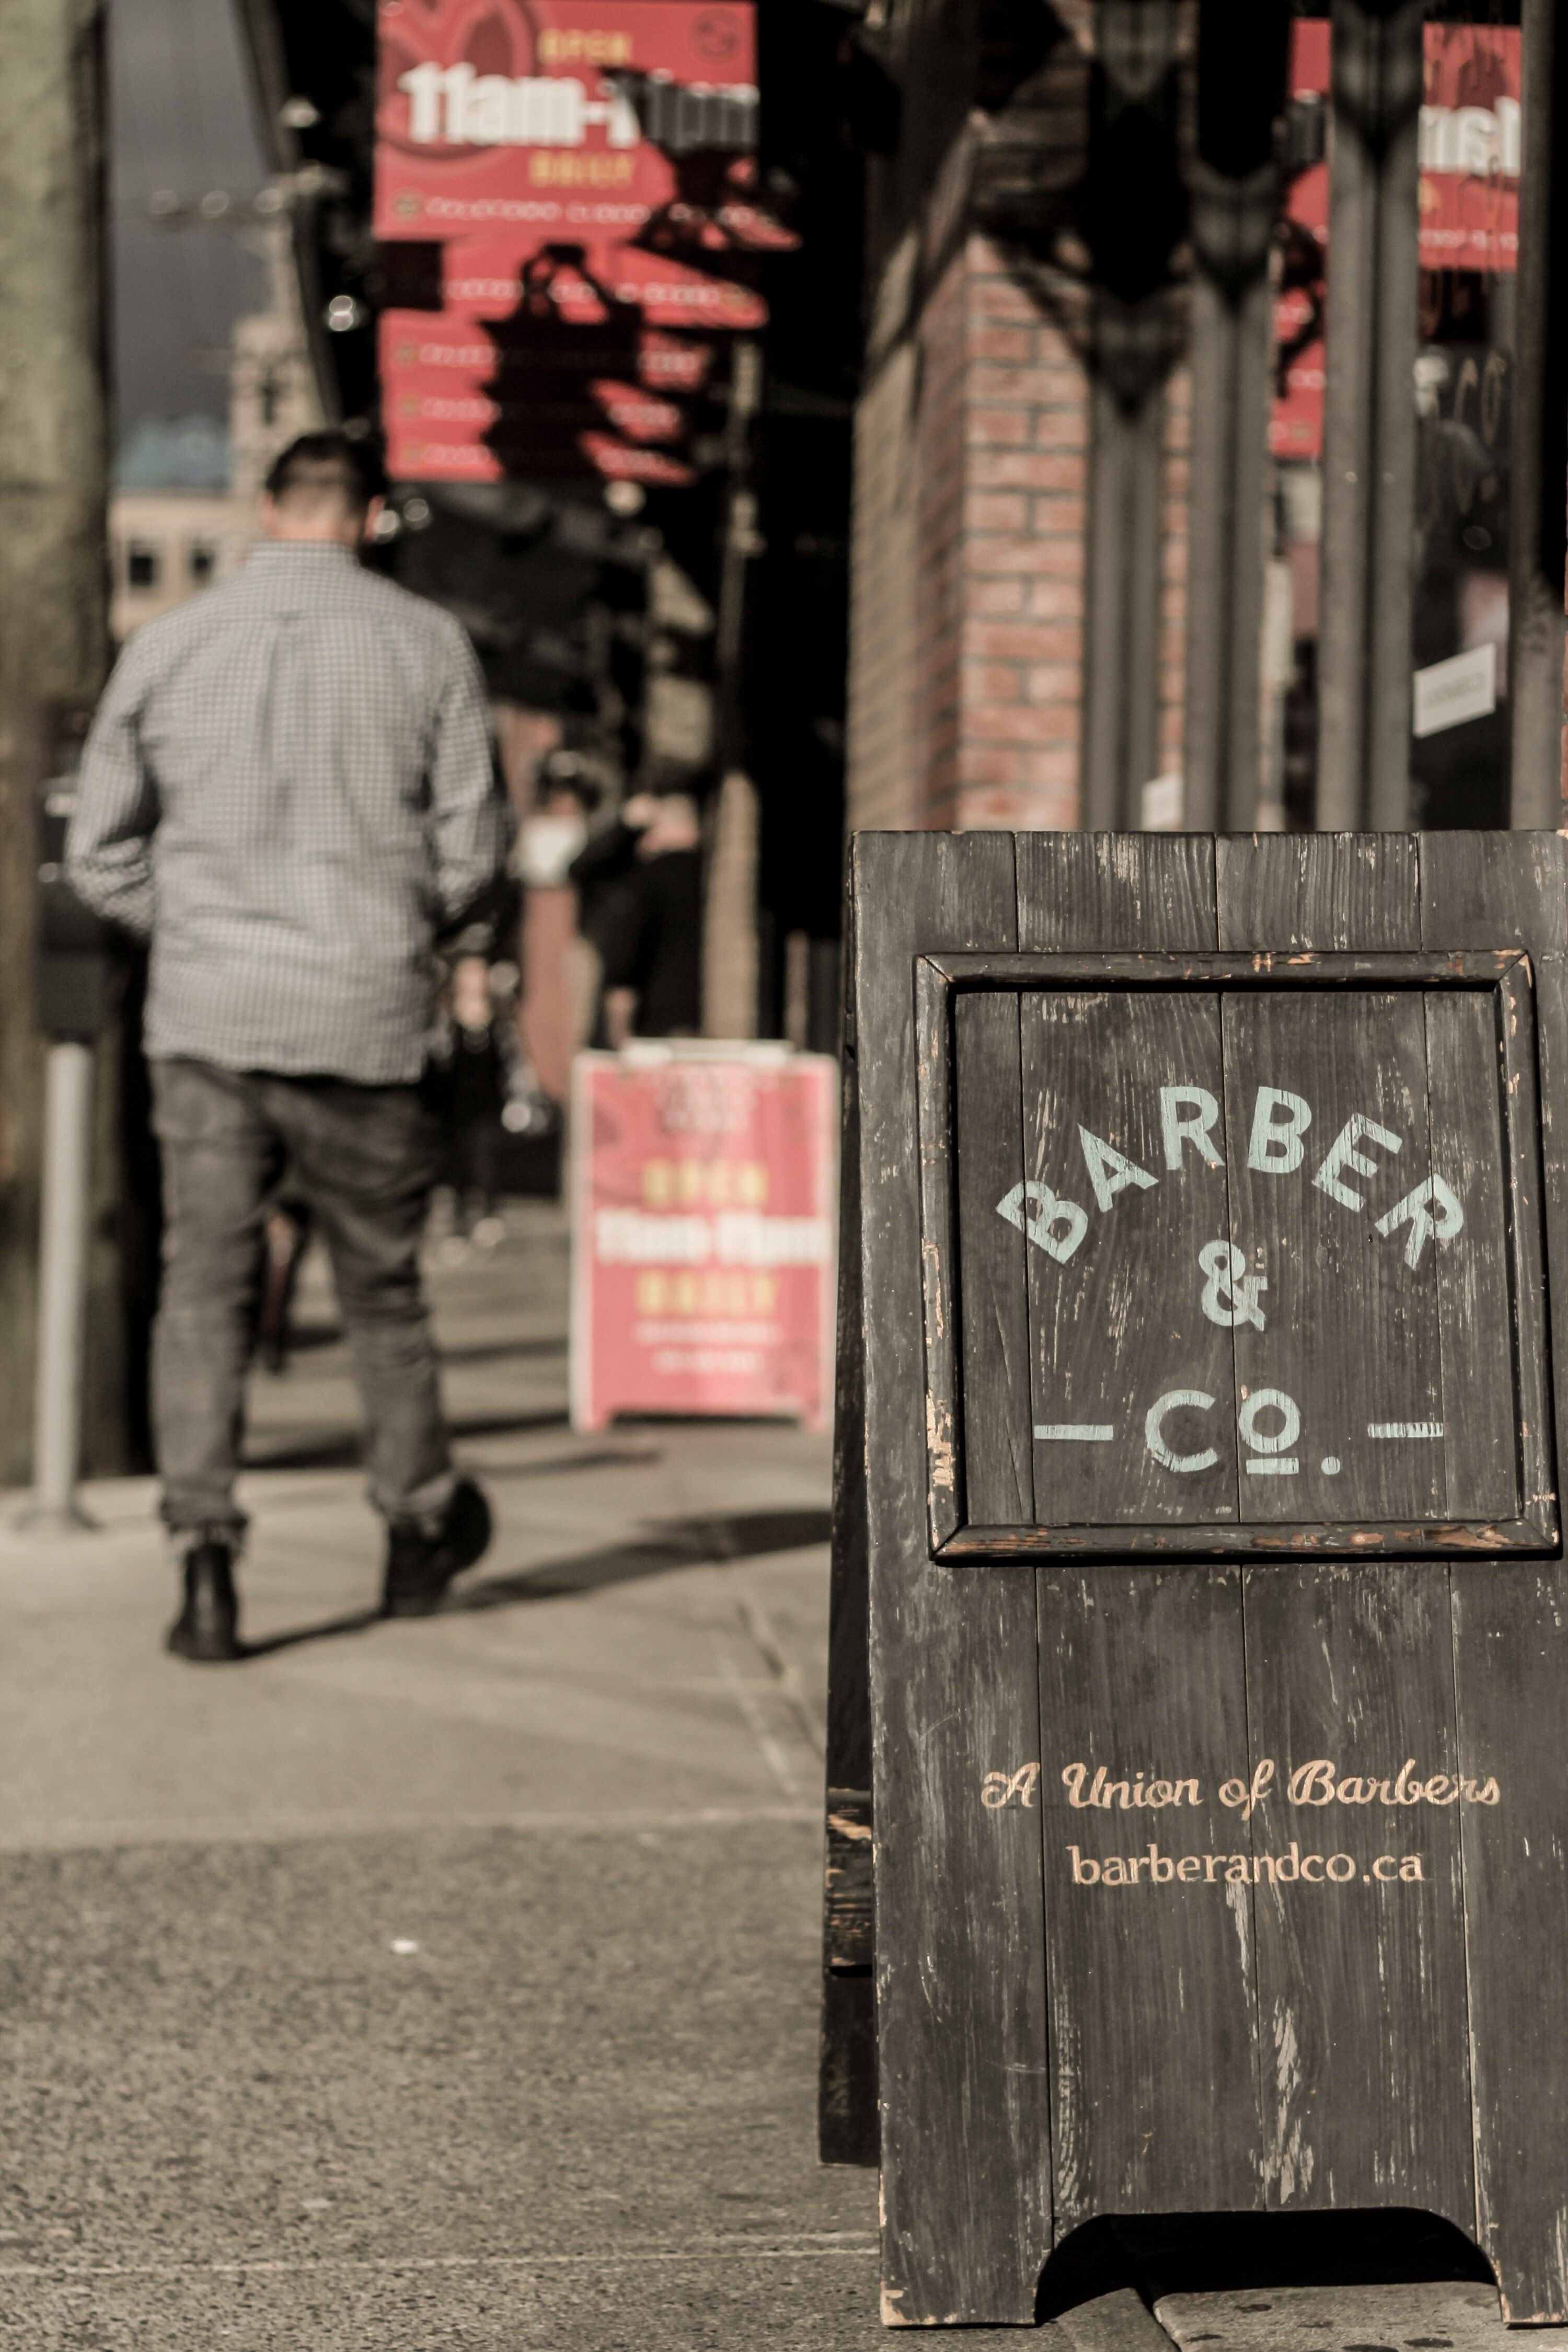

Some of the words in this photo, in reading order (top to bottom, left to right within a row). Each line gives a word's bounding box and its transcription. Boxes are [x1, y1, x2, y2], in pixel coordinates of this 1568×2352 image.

[996, 1086, 1465, 1271] BARBER
[1198, 1239, 1268, 1331] &
[981, 1761, 1040, 1809] A
[1062, 1761, 1203, 1810] Union
[1218, 1759, 1275, 1820] of
[1287, 1758, 1501, 1806] Barbers
[1066, 1842, 1424, 1885] barberandco.ca
